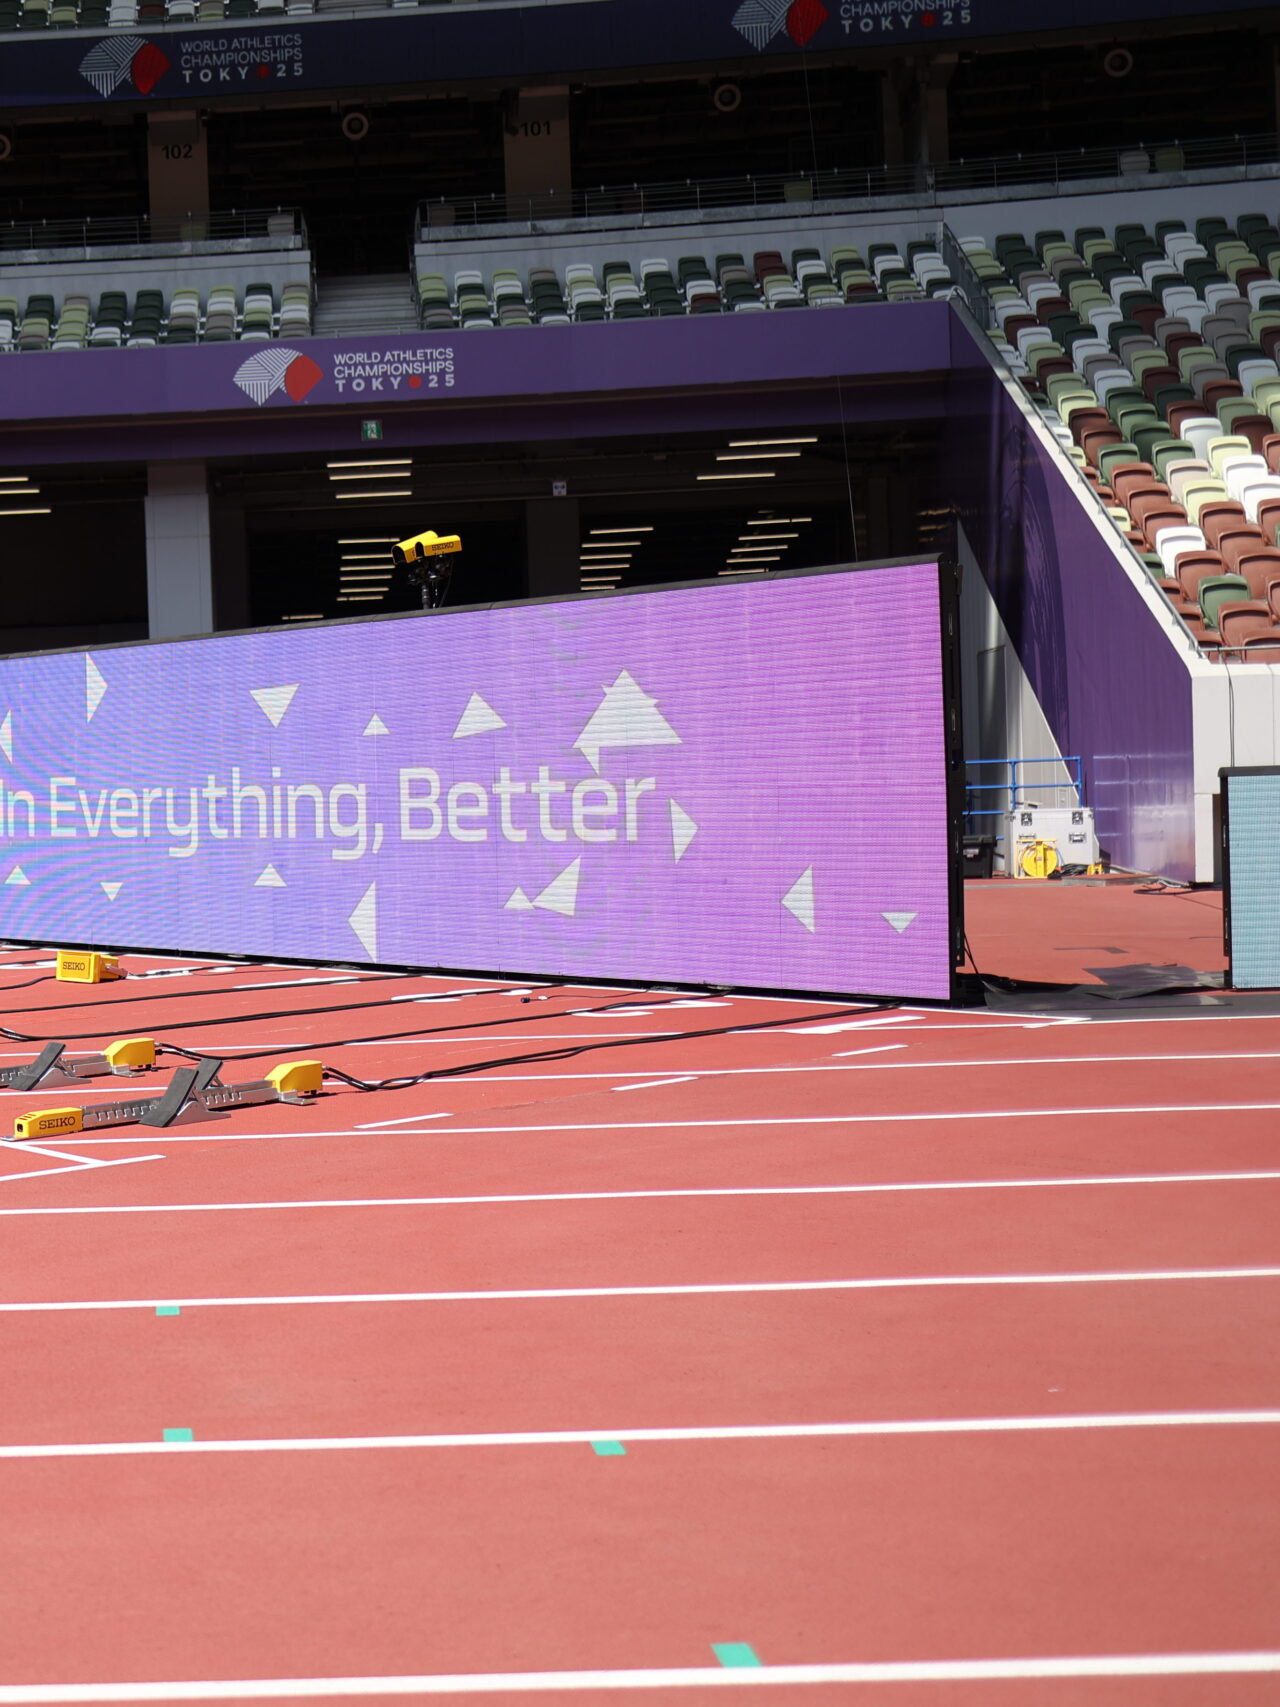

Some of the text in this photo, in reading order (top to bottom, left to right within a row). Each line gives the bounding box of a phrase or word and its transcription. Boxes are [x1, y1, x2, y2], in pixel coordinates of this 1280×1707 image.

[180, 34, 303, 53] WORLD ATHLETICS
[180, 47, 303, 68] CHAMPIONSHIPS
[521, 121, 551, 137] 101
[161, 144, 193, 159] 102
[334, 347, 454, 365] WORLD ATHLETICS
[334, 360, 455, 378] CHAMPIONSHIPS
[50, 766, 384, 861] Everything,
[400, 765, 657, 842] Better
[63, 961, 86, 971] SEIKO
[39, 1116, 76, 1130] SEIKO
